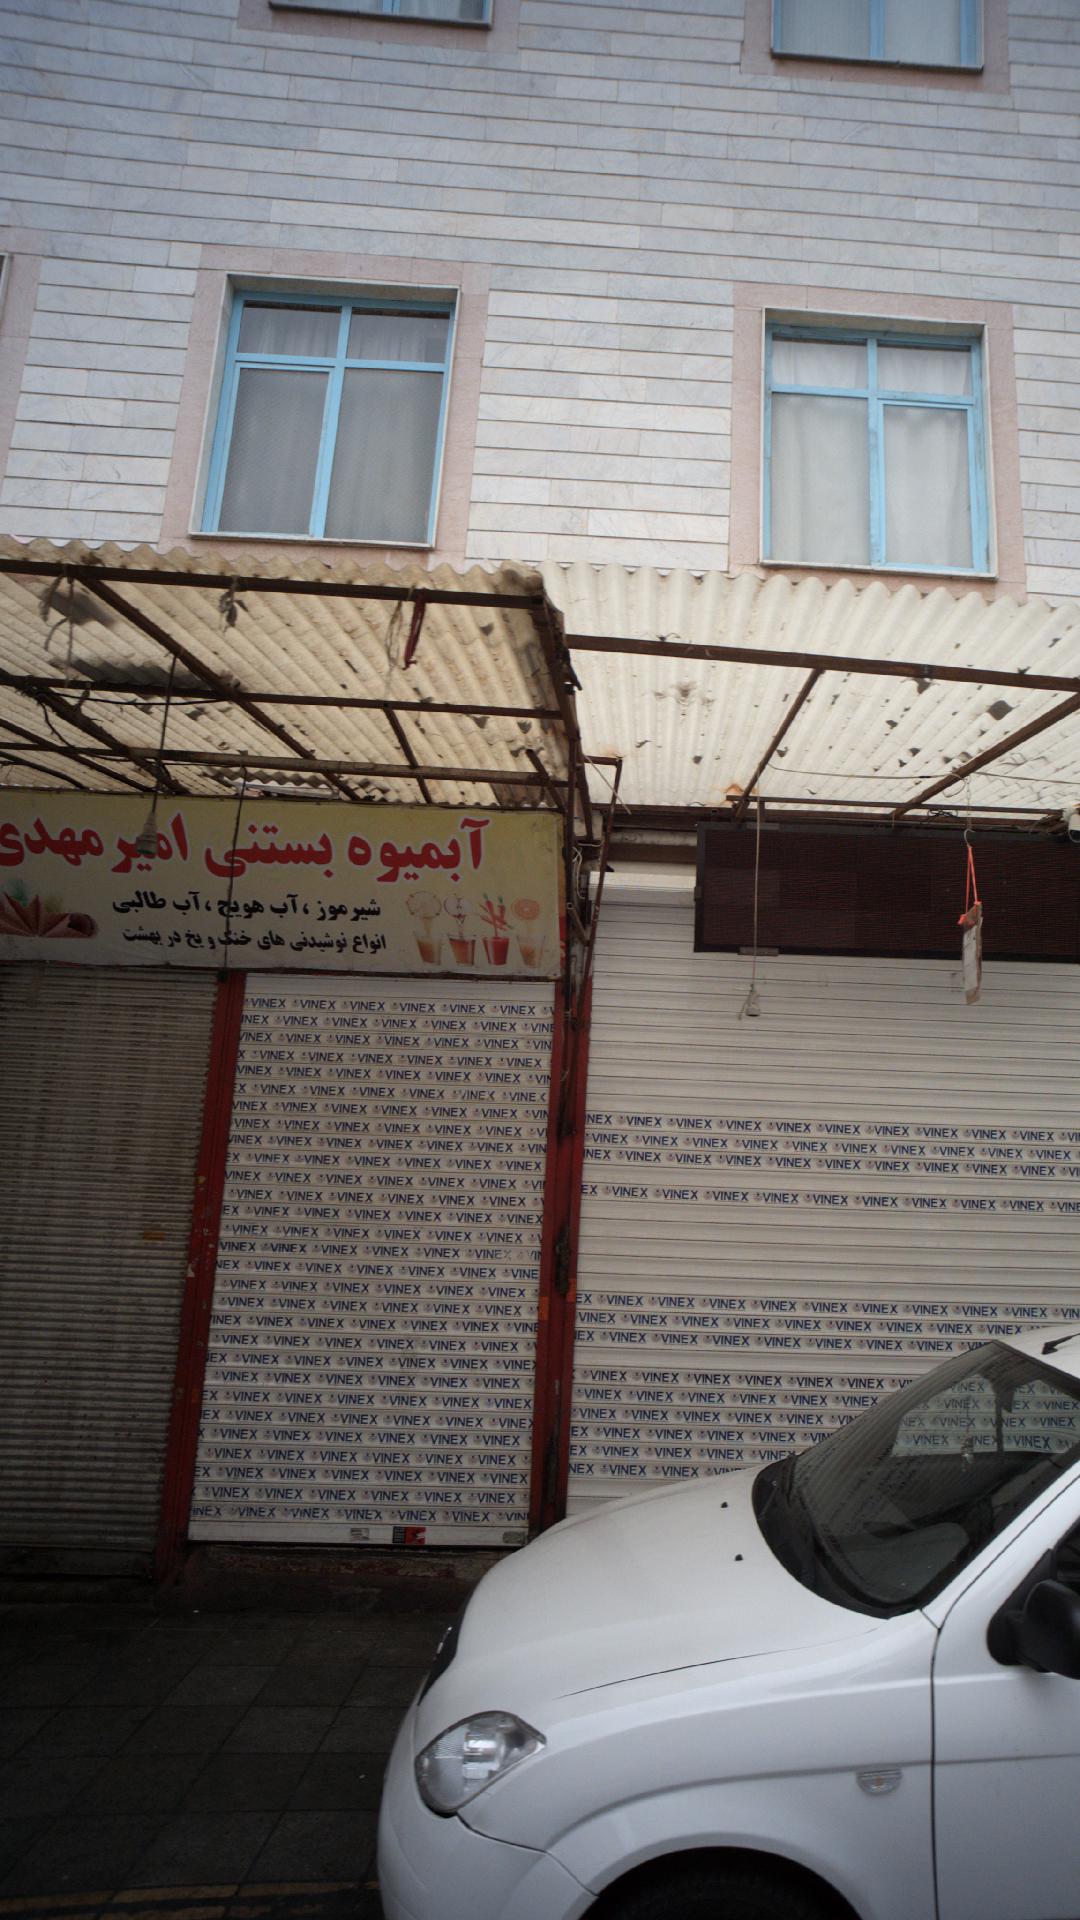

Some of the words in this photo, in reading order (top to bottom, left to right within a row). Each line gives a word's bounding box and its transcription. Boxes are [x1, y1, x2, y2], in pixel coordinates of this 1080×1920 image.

[205, 824, 333, 878] بستنی
[348, 818, 490, 882] آبمیوه
[112, 890, 166, 914] طالبی
[172, 892, 200, 915] آب
[217, 898, 264, 919] هویج
[270, 894, 298, 918] آب
[316, 900, 348, 921] موز
[350, 898, 381, 921] شیر
[122, 926, 161, 946] بهشت
[168, 931, 181, 948] در
[184, 929, 204, 948] یخ
[207, 936, 216, 949] و
[257, 930, 285, 948] های
[289, 932, 347, 952] نوشیدنی
[352, 934, 386, 954] انواع
[251, 998, 286, 1008] VINEX
[300, 999, 336, 1010] VINEX
[350, 1001, 385, 1010] VINEX
[400, 1002, 435, 1012] VINEX
[449, 1004, 485, 1013] VINEX
[500, 1005, 536, 1015] VINEX
[259, 1050, 294, 1060] VINEX
[308, 1052, 344, 1062] VINEX
[357, 1053, 393, 1064] VINEX
[407, 1055, 443, 1065] VINEX
[456, 1056, 493, 1067] VINEX
[506, 1058, 542, 1067] VINEX
[237, 1065, 272, 1075] VINEX
[286, 1067, 321, 1077] VINEX
[335, 1068, 371, 1078] VINEX
[385, 1070, 421, 1080] VINEX
[435, 1071, 471, 1082] VINEX
[485, 1073, 521, 1083] VINEX
[281, 1102, 317, 1112] VINEX
[331, 1104, 367, 1114] VINEX
[381, 1105, 417, 1115] VINEX
[431, 1107, 467, 1117] VINEX
[481, 1108, 518, 1118] VINEX
[276, 1136, 312, 1146] VINEX
[326, 1138, 362, 1148] VINEX
[376, 1139, 412, 1149] VINEX
[426, 1141, 463, 1151] VINEX
[477, 1142, 513, 1152] VINEX
[592, 1133, 628, 1144] VINEX
[642, 1135, 678, 1146] VINEX
[692, 1138, 728, 1148] VINEX
[742, 1139, 778, 1150] VINEX
[792, 1141, 828, 1151] VINEX
[841, 1143, 877, 1153] VINEX
[890, 1145, 926, 1155] VINEX
[939, 1146, 975, 1156] VINEX
[988, 1148, 1023, 1158] VINEX
[1036, 1150, 1071, 1159] VINEX
[254, 1153, 290, 1163] VINEX
[304, 1155, 340, 1165] VINEX
[354, 1156, 390, 1167] VINEX
[404, 1158, 441, 1168] VINEX
[455, 1159, 491, 1169] VINEX
[505, 1161, 542, 1171] VINEX
[612, 1187, 648, 1197] VINEX
[662, 1189, 699, 1200] VINEX
[712, 1191, 749, 1201] VINEX
[762, 1193, 799, 1203] VINEX
[813, 1194, 848, 1205] VINEX
[862, 1196, 898, 1206] VINEX
[911, 1198, 947, 1208] VINEX
[960, 1199, 996, 1209] VINEX
[1009, 1200, 1044, 1211] VINEX
[253, 1206, 290, 1217] VINEX
[304, 1208, 340, 1218] VINEX
[354, 1210, 391, 1220] VINEX
[405, 1211, 442, 1221] VINEX
[456, 1213, 493, 1223] VINEX
[507, 1214, 543, 1224] VINEX
[220, 1241, 256, 1252] VINEX
[270, 1243, 307, 1253] VINEX
[321, 1244, 358, 1255] VINEX
[372, 1246, 409, 1257] VINEX
[423, 1248, 460, 1258] VINEX
[230, 1279, 267, 1290] VINEX
[281, 1281, 318, 1291] VINEX
[332, 1283, 370, 1293] VINEX
[384, 1284, 421, 1294] VINEX
[436, 1285, 474, 1296] VINEX
[488, 1287, 526, 1298] VINEX
[256, 1316, 293, 1327] VINEX
[307, 1317, 344, 1328] VINEX
[358, 1319, 396, 1330] VINEX
[410, 1320, 447, 1331] VINEX
[462, 1322, 499, 1332] VINEX
[578, 1313, 616, 1323] VINEX
[630, 1315, 667, 1325] VINEX
[682, 1317, 719, 1327] VINEX
[733, 1318, 770, 1328] VINEX
[784, 1320, 821, 1330] VINEX
[835, 1321, 872, 1331] VINEX
[886, 1322, 922, 1332] VINEX
[936, 1323, 973, 1334] VINEX
[987, 1325, 1022, 1334] VINEX
[222, 1334, 259, 1345] VINEX
[273, 1335, 310, 1346] VINEX
[325, 1338, 362, 1348] VINEX
[377, 1339, 414, 1349] VINEX
[429, 1340, 467, 1351] VINEX
[481, 1341, 519, 1352] VINEX
[221, 1371, 259, 1382] VINEX
[273, 1372, 311, 1383] VINEX
[325, 1374, 363, 1385] VINEX
[378, 1375, 415, 1386] VINEX
[430, 1377, 468, 1388] VINEX
[482, 1378, 520, 1388] VINEX
[590, 1370, 627, 1381] VINEX
[642, 1372, 679, 1382] VINEX
[693, 1373, 730, 1384] VINEX
[745, 1375, 782, 1386] VINEX
[796, 1377, 833, 1387] VINEX
[847, 1378, 884, 1388] VINEX
[220, 1428, 258, 1439] VINEX
[273, 1430, 310, 1441] VINEX
[325, 1431, 363, 1442] VINEX
[378, 1432, 415, 1443] VINEX
[430, 1434, 468, 1445] VINEX
[482, 1435, 520, 1446] VINEX
[603, 1427, 640, 1438] VINEX
[655, 1428, 693, 1439] VINEX
[707, 1430, 744, 1441] VINEX
[758, 1431, 796, 1442] VINEX
[602, 1446, 640, 1457] VINEX
[654, 1447, 692, 1458] VINEX
[706, 1448, 744, 1459] VINEX
[225, 1467, 264, 1478] VINEX
[278, 1468, 317, 1479] VINEX
[331, 1469, 370, 1480] VINEX
[384, 1470, 423, 1481] VINEX
[437, 1472, 476, 1483] VINEX
[490, 1473, 528, 1484] VINEX
[609, 1464, 647, 1475] VINEX
[661, 1466, 699, 1477] VINEX
[237, 1506, 276, 1517] VINEX
[291, 1507, 330, 1519] VINEX
[344, 1509, 383, 1520] VINEX
[398, 1510, 437, 1521] VINEX
[452, 1511, 490, 1522] VINEX
